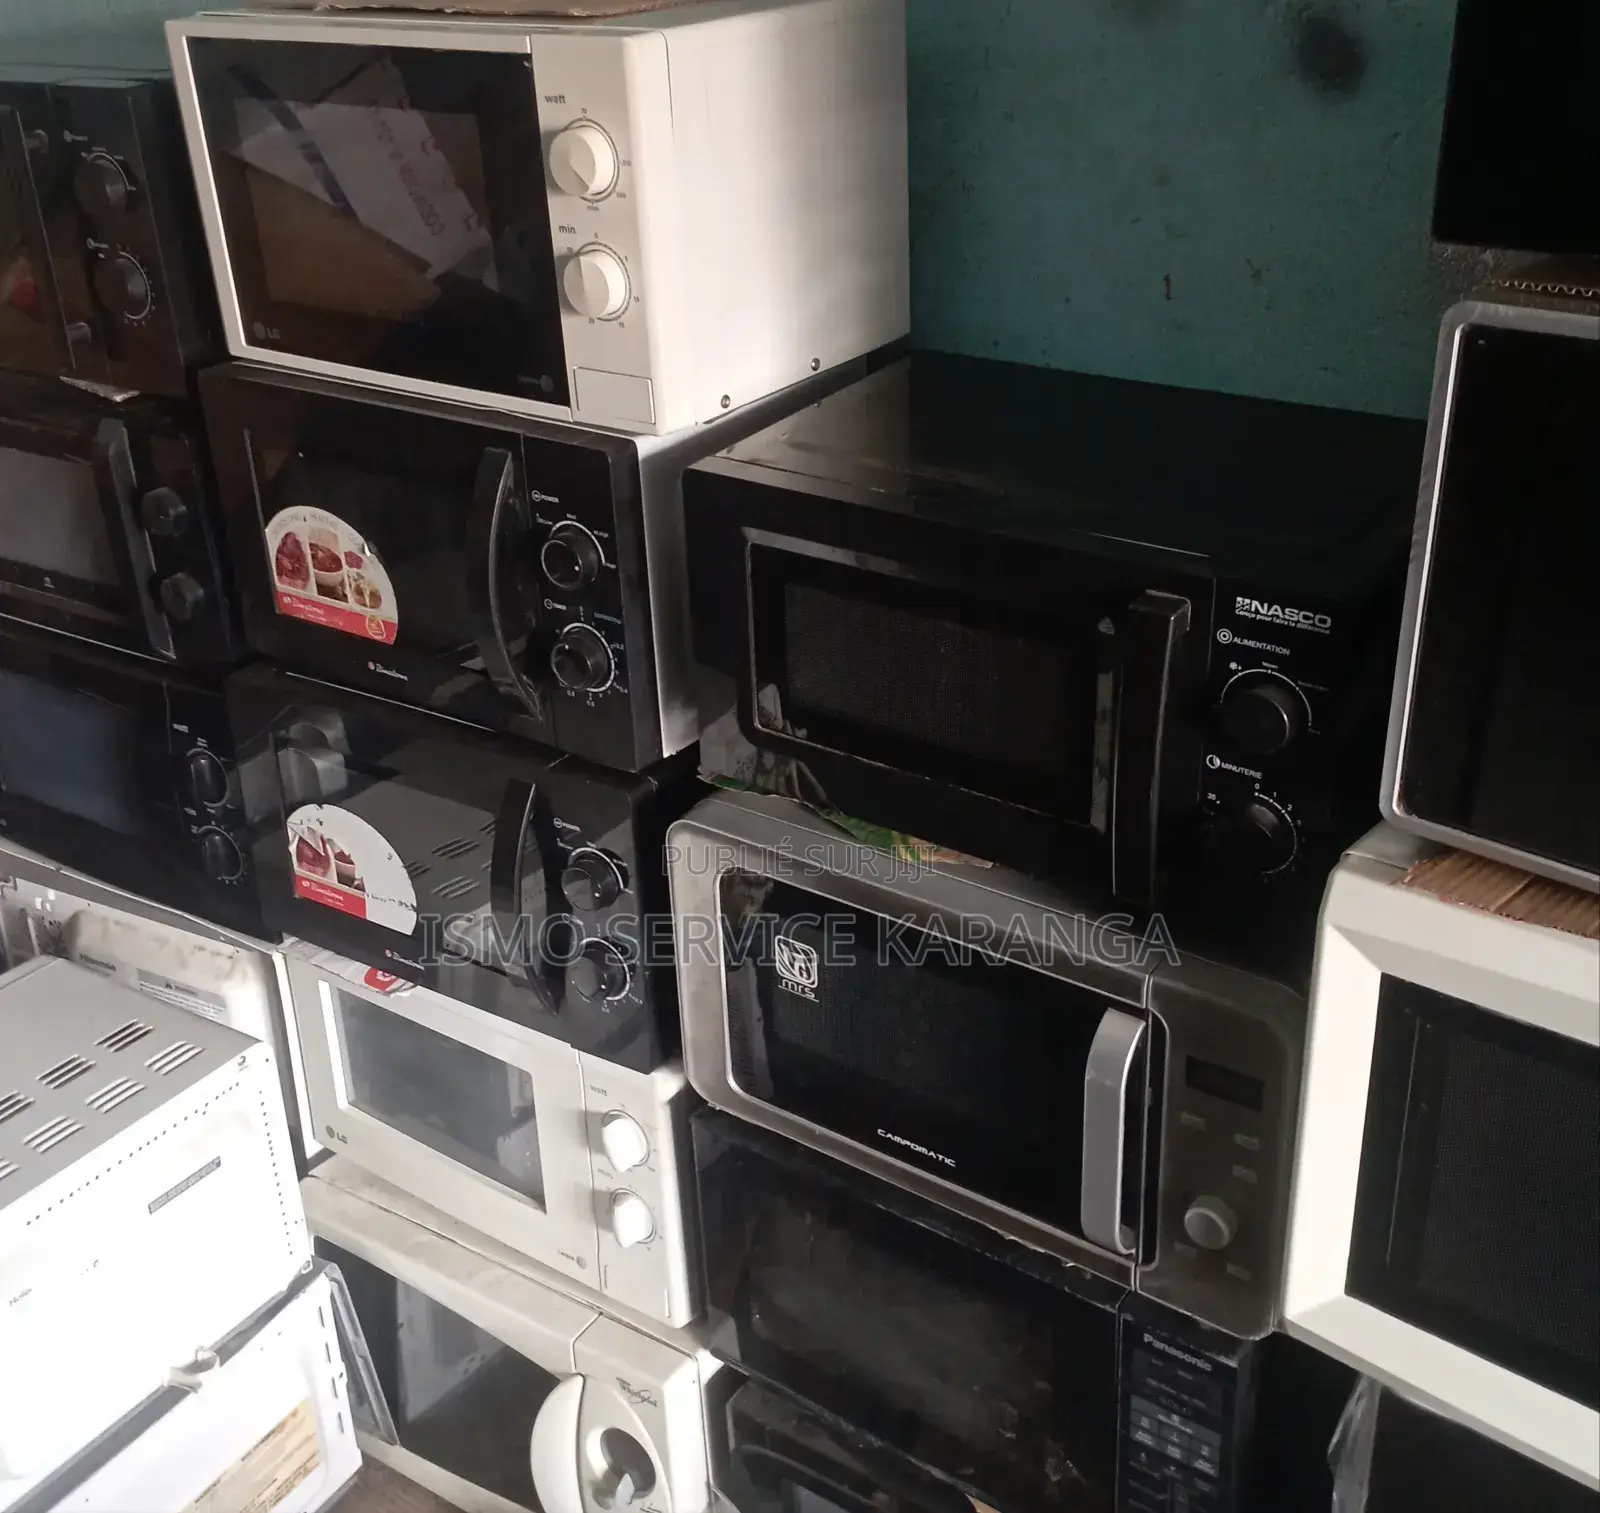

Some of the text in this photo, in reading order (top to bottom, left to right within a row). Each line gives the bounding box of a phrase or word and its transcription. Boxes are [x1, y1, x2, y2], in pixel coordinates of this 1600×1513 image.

[544, 94, 566, 104] watt
[558, 225, 576, 235] min
[1250, 599, 1332, 628] NASCO
[1232, 636, 1291, 656] ALIMENTATION
[1220, 761, 1263, 780] MINUTERIE
[1287, 803, 1293, 811] 2
[782, 979, 815, 998] mrs
[877, 1128, 956, 1168] CAMPOMATIC
